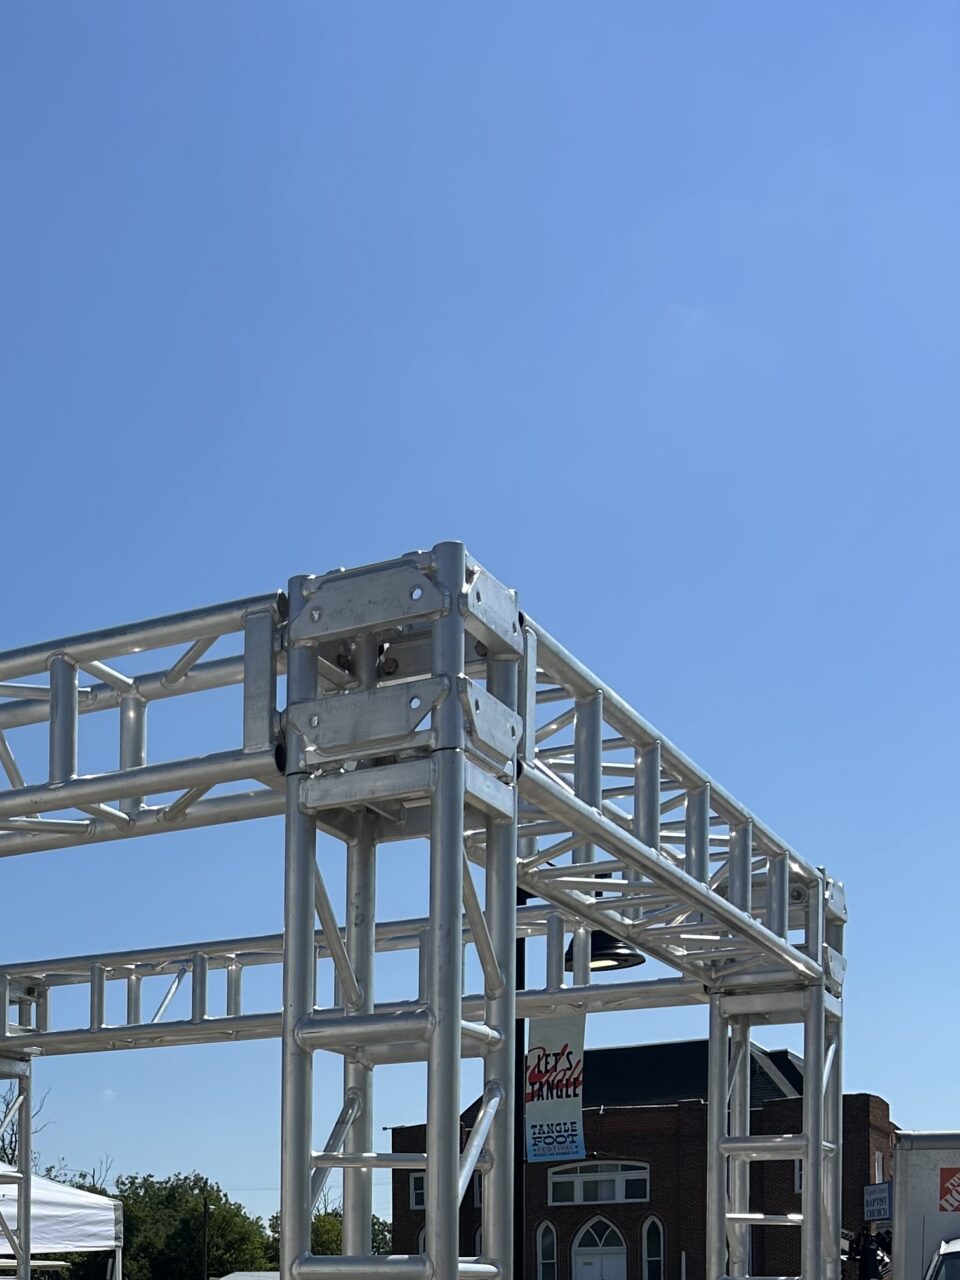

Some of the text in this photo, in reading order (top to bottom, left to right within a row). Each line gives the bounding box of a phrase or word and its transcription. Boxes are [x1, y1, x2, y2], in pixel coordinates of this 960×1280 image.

[537, 1051, 573, 1073] LET'S
[529, 1077, 579, 1102] TANGLE
[530, 1121, 578, 1135] TANGLE
[531, 1133, 578, 1147] FOOT
